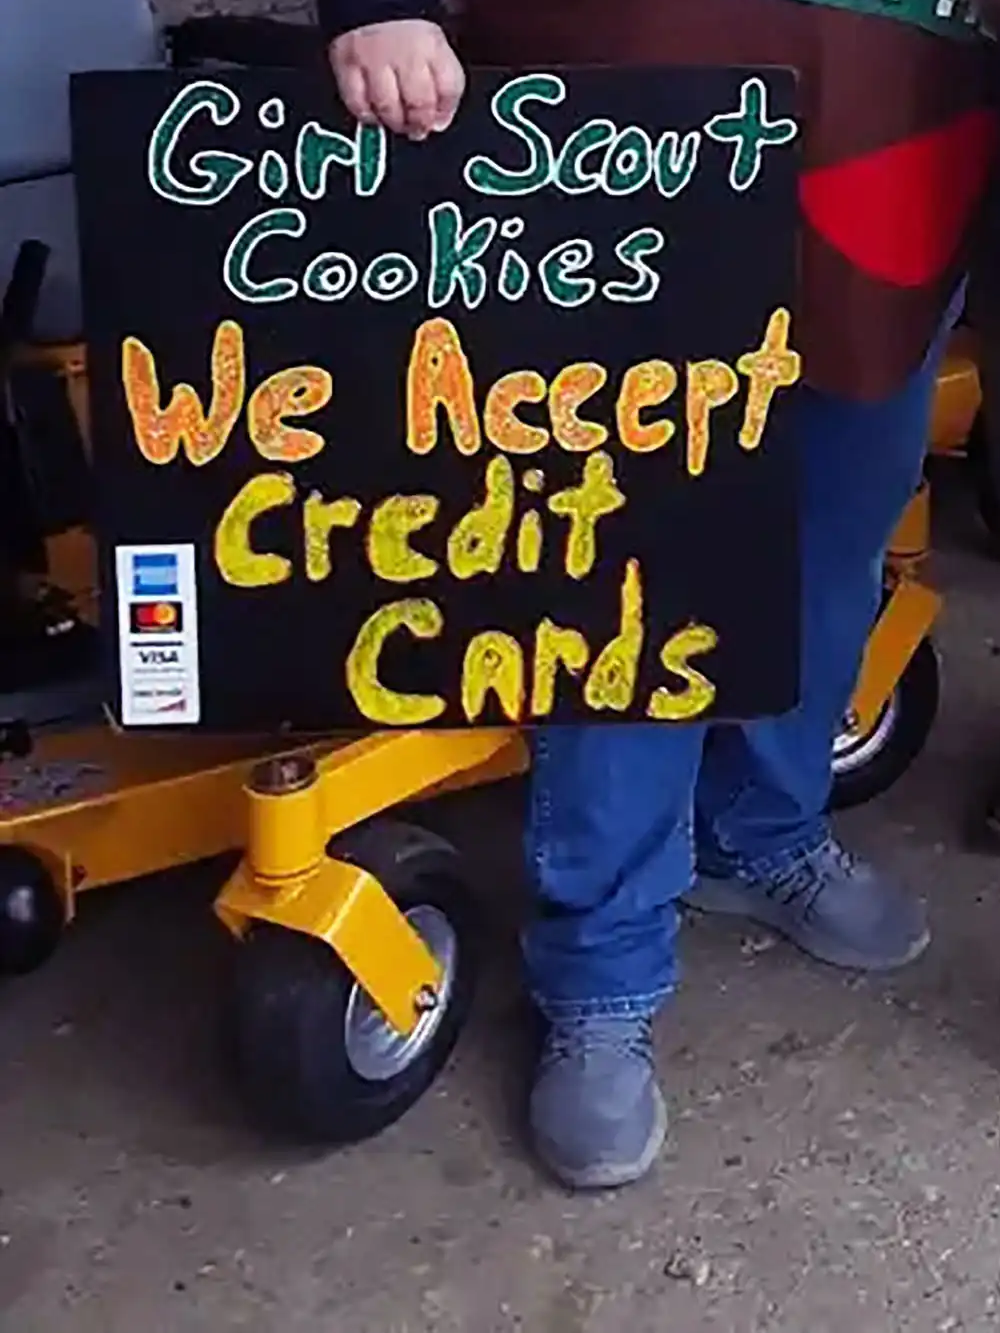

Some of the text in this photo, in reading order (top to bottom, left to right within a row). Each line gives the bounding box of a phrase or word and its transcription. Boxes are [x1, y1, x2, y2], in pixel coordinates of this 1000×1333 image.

[149, 73, 797, 205] Girl Scout
[224, 202, 665, 309] Cookies
[122, 307, 801, 476] We Accept
[214, 452, 626, 588] Credit
[138, 650, 180, 664] VISA
[346, 558, 719, 726] Cards
